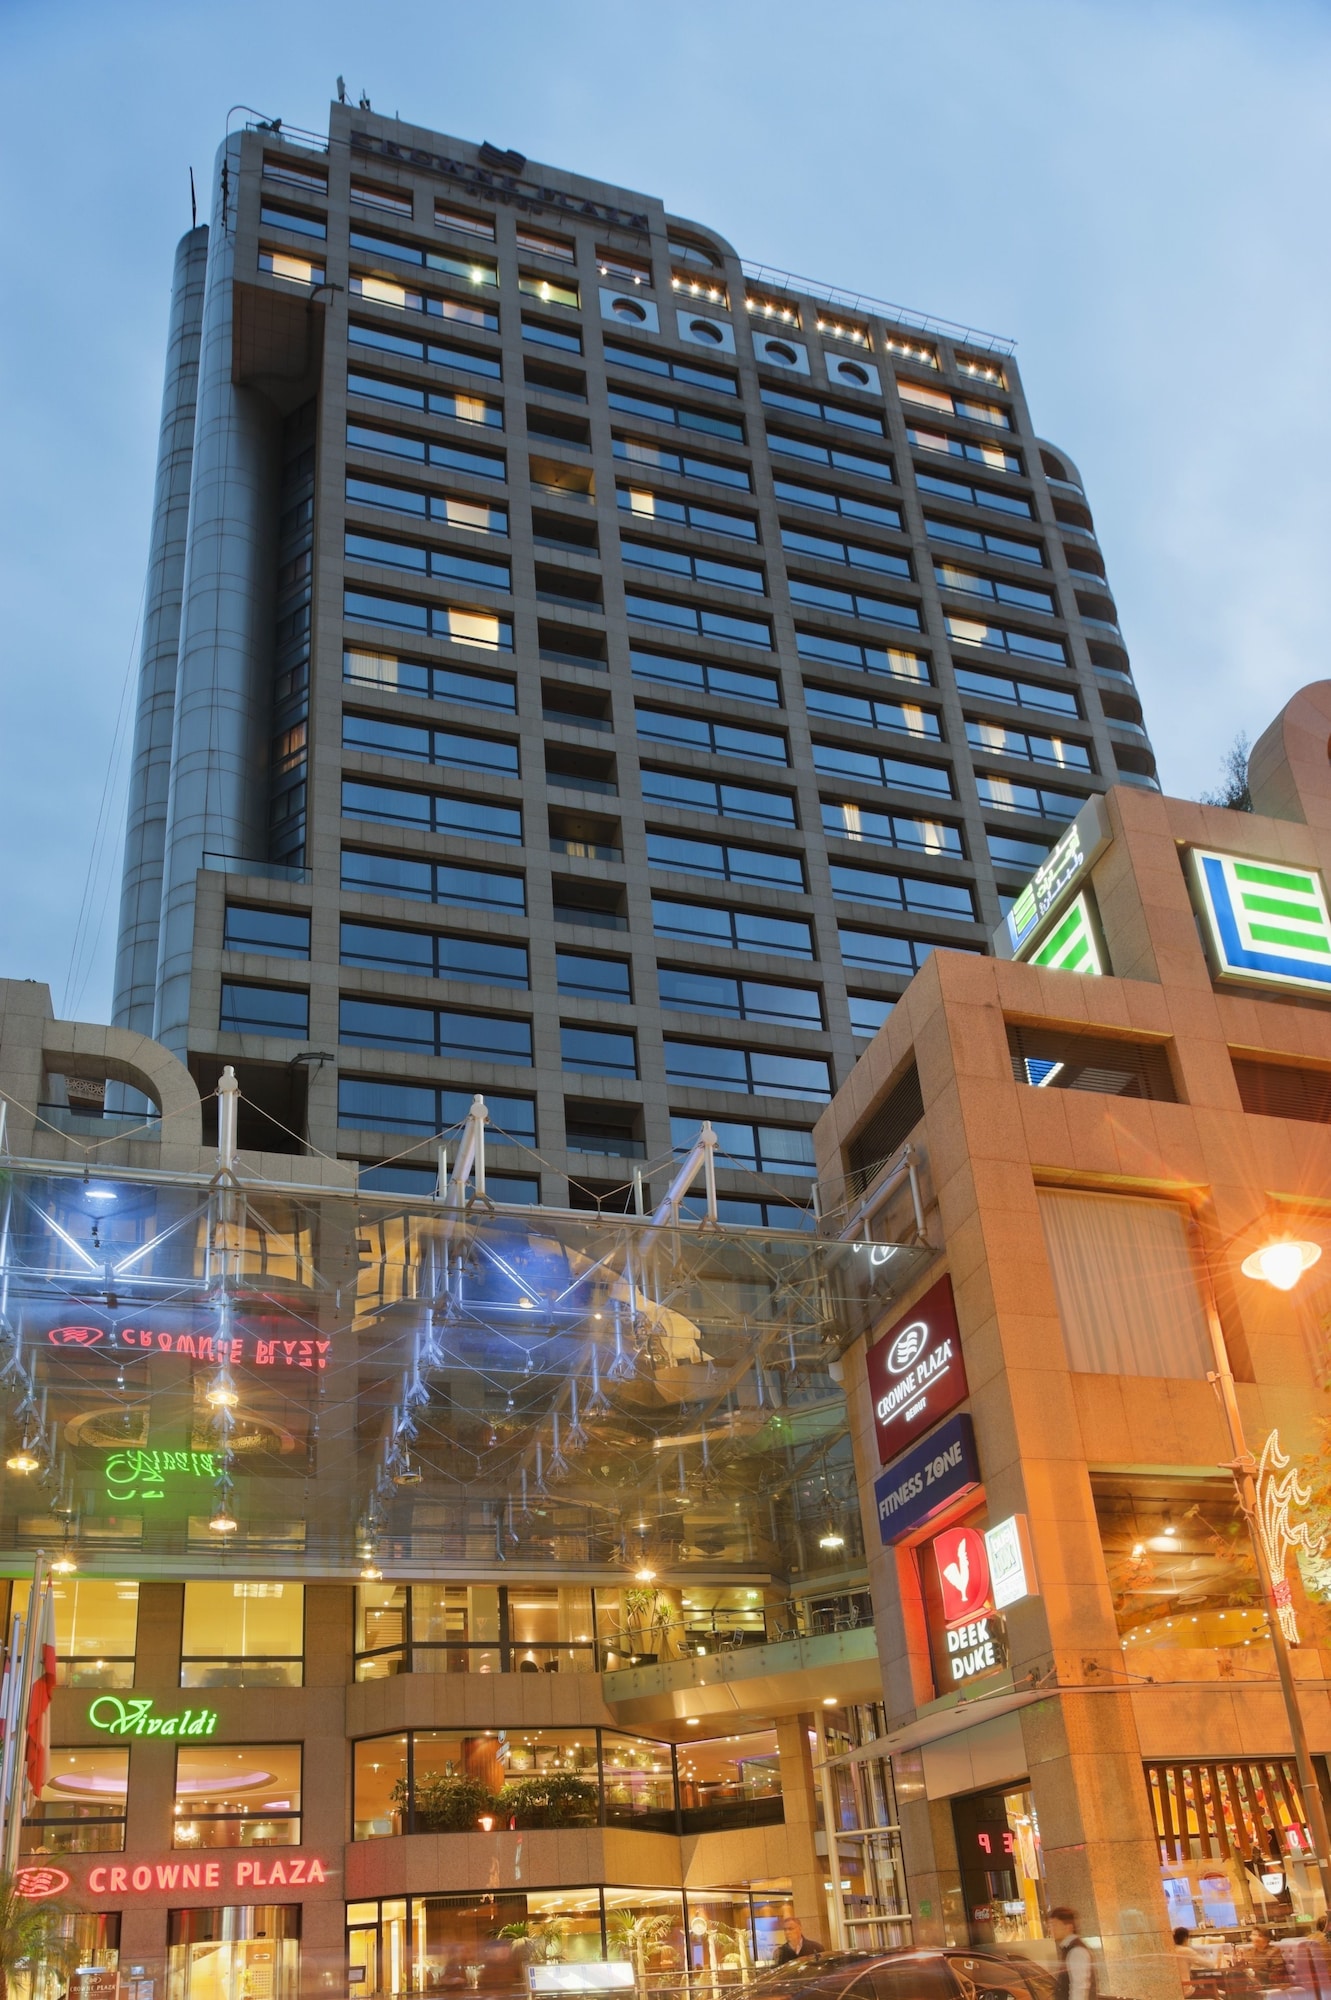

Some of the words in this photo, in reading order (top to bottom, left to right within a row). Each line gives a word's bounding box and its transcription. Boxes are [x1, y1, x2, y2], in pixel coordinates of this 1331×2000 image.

[877, 1371, 917, 1418] CROWNE
[916, 1341, 952, 1383] PLAZA
[905, 1397, 927, 1421] BEIRUT
[878, 1472, 924, 1520] FITNESS
[924, 1441, 963, 1486] ZONE
[947, 1618, 990, 1652] DEEK
[951, 1642, 995, 1680] DUKE
[89, 1696, 217, 1735] Vivaldi
[89, 1863, 219, 1892] CROWNE
[236, 1860, 325, 1886] PLAZA
